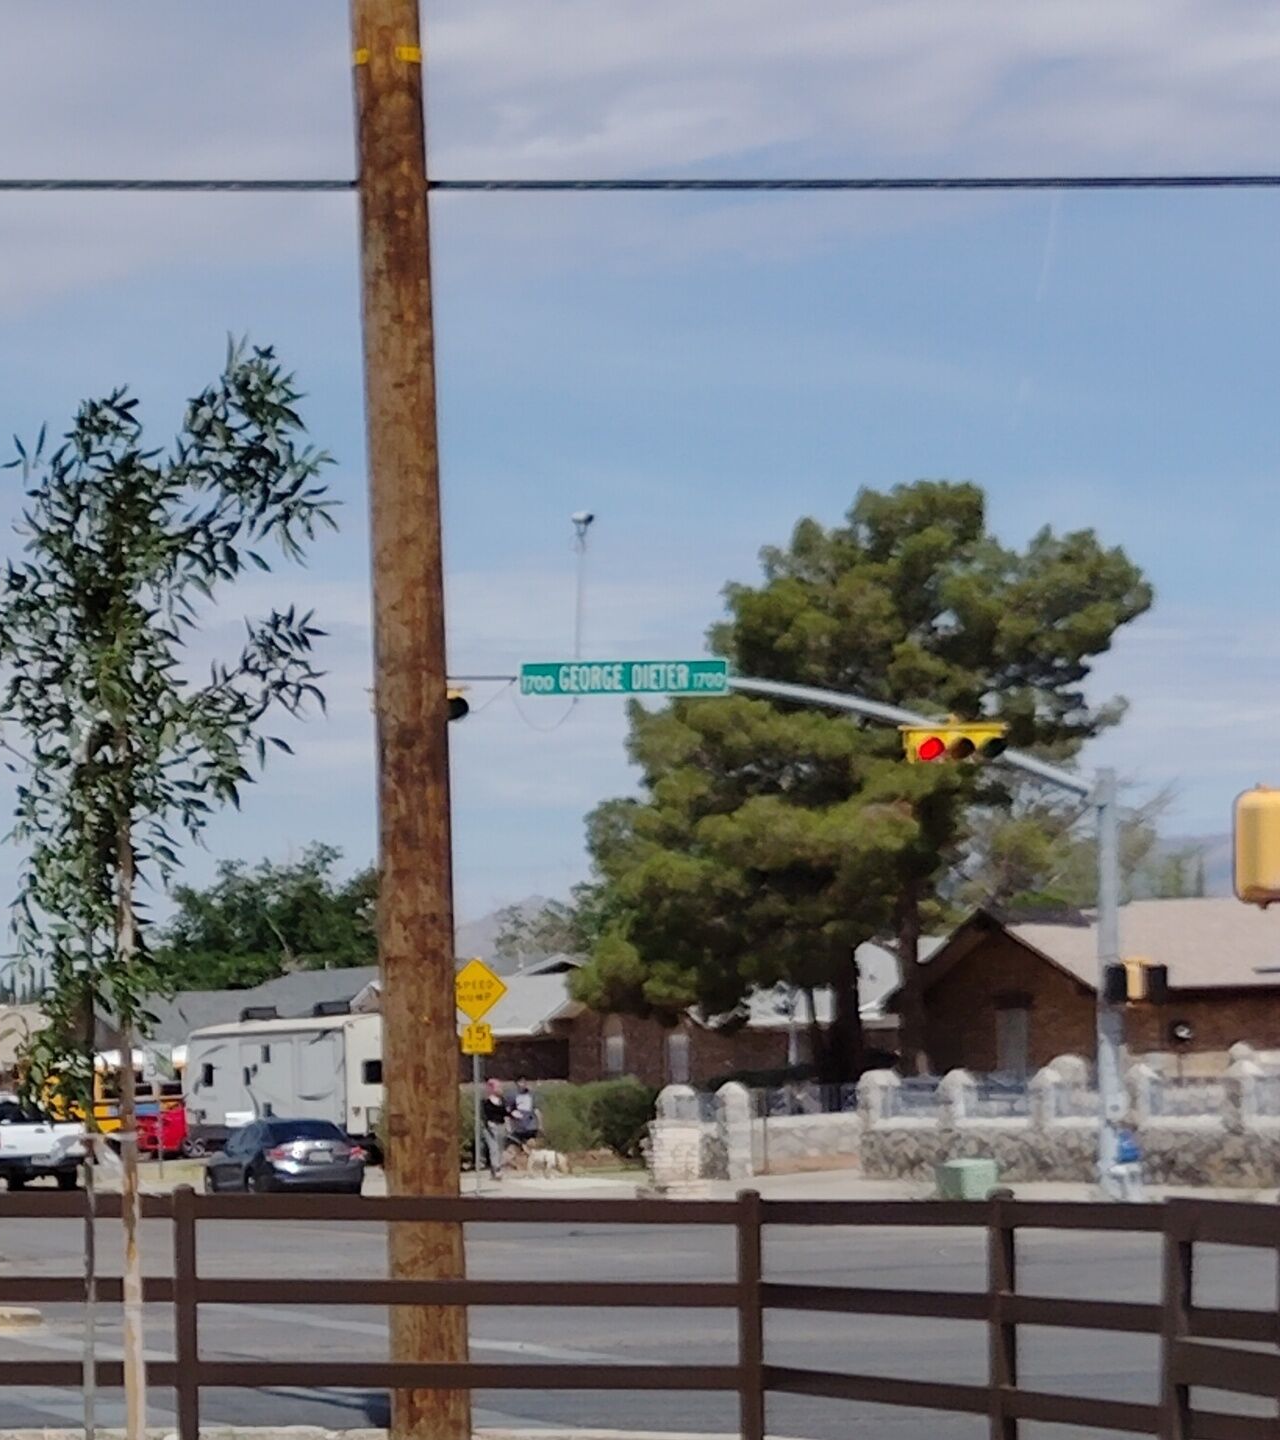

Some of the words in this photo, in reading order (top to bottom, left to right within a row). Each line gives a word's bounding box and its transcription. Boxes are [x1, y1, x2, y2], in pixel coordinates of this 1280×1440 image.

[559, 665, 625, 691] GEORGE
[631, 664, 689, 690] DIETER
[456, 980, 494, 989] SPEED
[458, 992, 491, 1001] HUMP
[467, 1026, 487, 1041] 15
